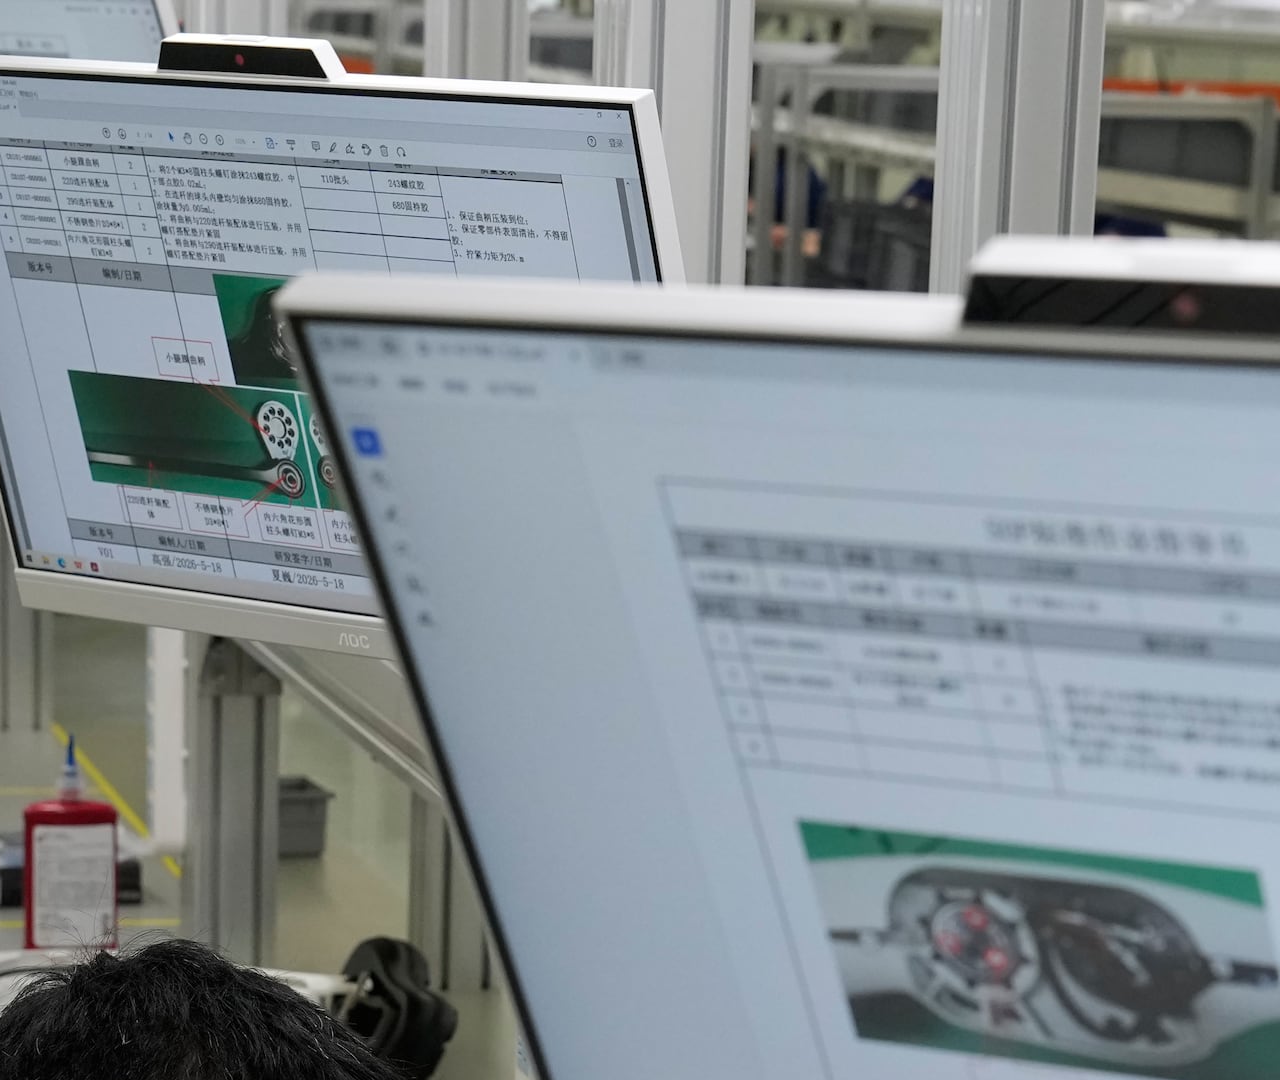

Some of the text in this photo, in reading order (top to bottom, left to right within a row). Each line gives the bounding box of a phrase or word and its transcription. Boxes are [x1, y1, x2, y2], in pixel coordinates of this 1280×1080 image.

[27, 261, 54, 274] 版本号
[102, 267, 142, 283] 编制/日期
[263, 511, 313, 527] 内六角花形圆
[89, 526, 114, 539] 版本号
[158, 536, 206, 551] 编制人/日期
[152, 553, 223, 574] 高强/2026-5-18
[274, 550, 333, 568] 研发签字/日期
[339, 632, 371, 649] AOC
